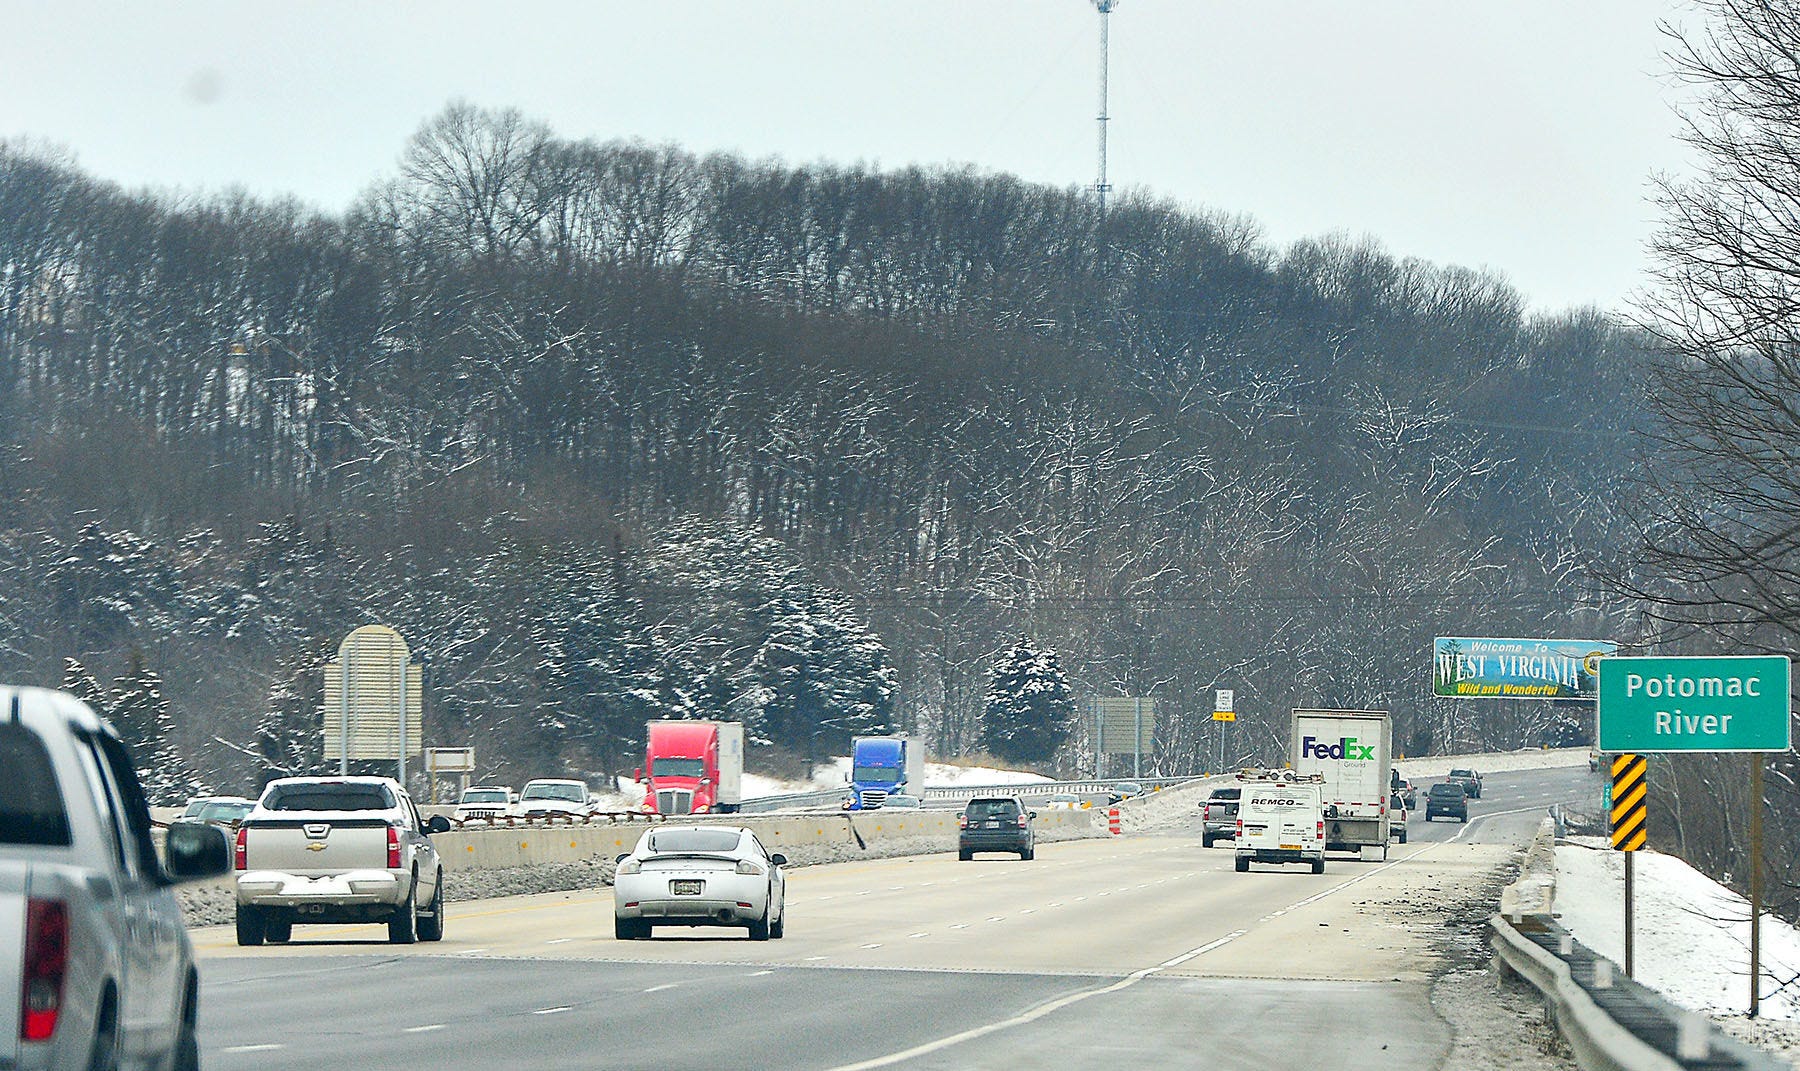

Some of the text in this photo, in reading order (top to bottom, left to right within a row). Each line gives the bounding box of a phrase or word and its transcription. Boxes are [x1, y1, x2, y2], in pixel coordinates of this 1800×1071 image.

[1471, 641, 1548, 653] Welcome To
[1439, 654, 1579, 690] WEST VIRGINIA
[1457, 683, 1559, 696] Wild and Wonderful
[1626, 673, 1761, 698] Potomac
[1655, 709, 1733, 735] River
[1302, 736, 1376, 761] FedEx
[1250, 798, 1295, 806] REMCO
